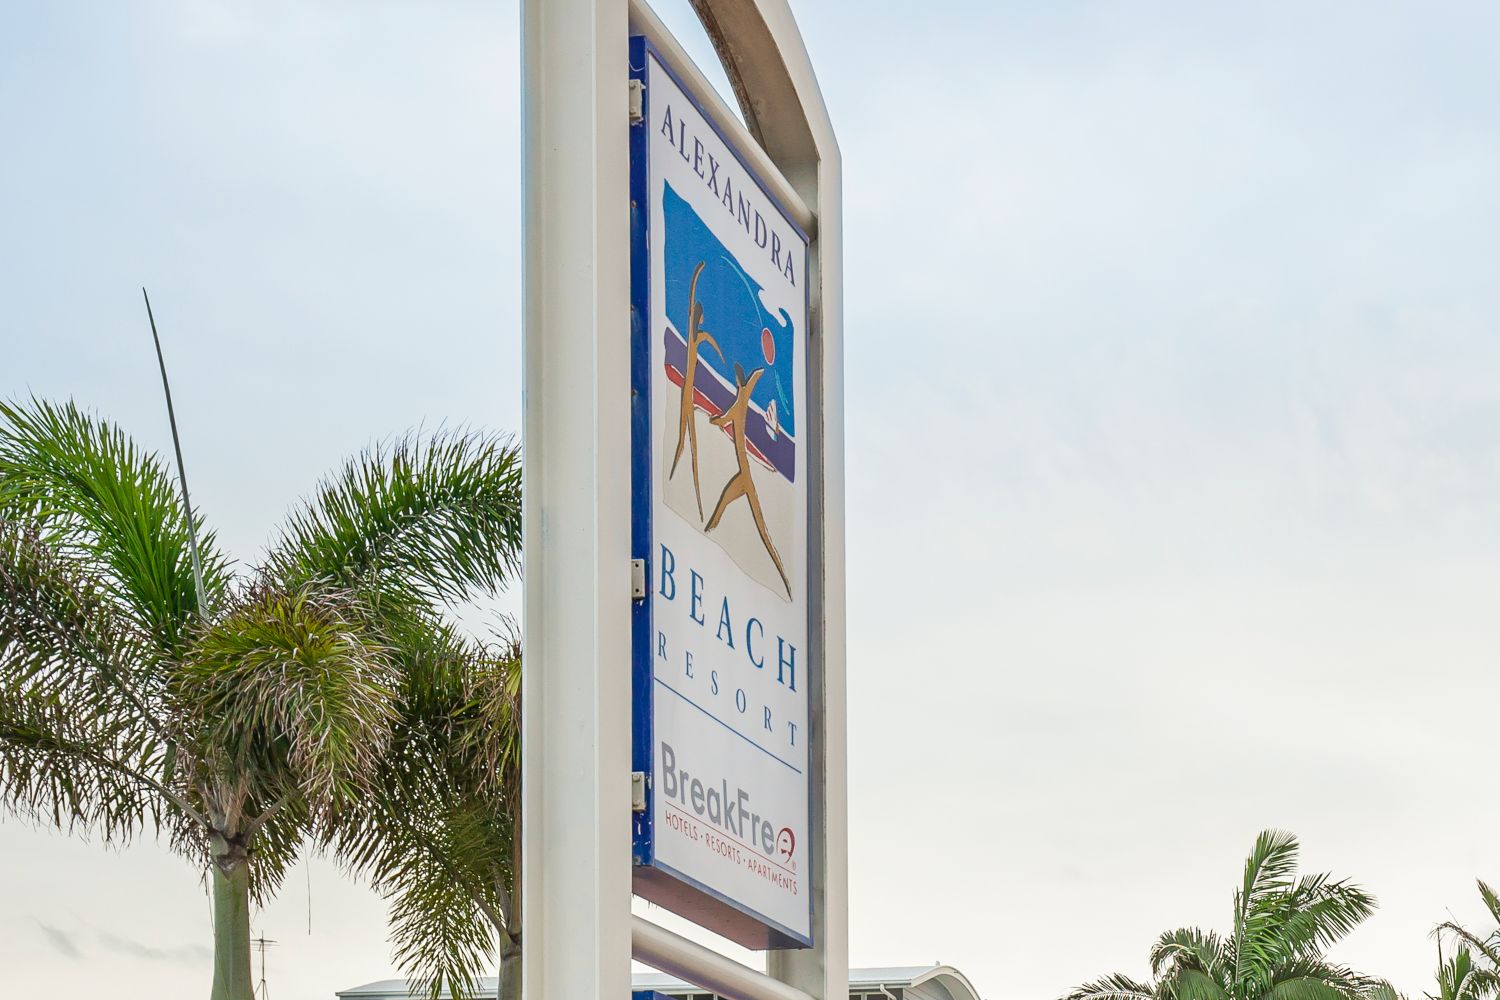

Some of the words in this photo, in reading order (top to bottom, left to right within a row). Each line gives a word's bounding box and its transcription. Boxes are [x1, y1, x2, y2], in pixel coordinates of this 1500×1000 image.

[660, 104, 796, 288] ALEXANDRA
[658, 542, 798, 693] BEACH
[658, 630, 799, 746] RESORT
[665, 810, 698, 841] HOTELS
[705, 833, 741, 865] RESORTS
[747, 859, 798, 896] APARTMENTS
